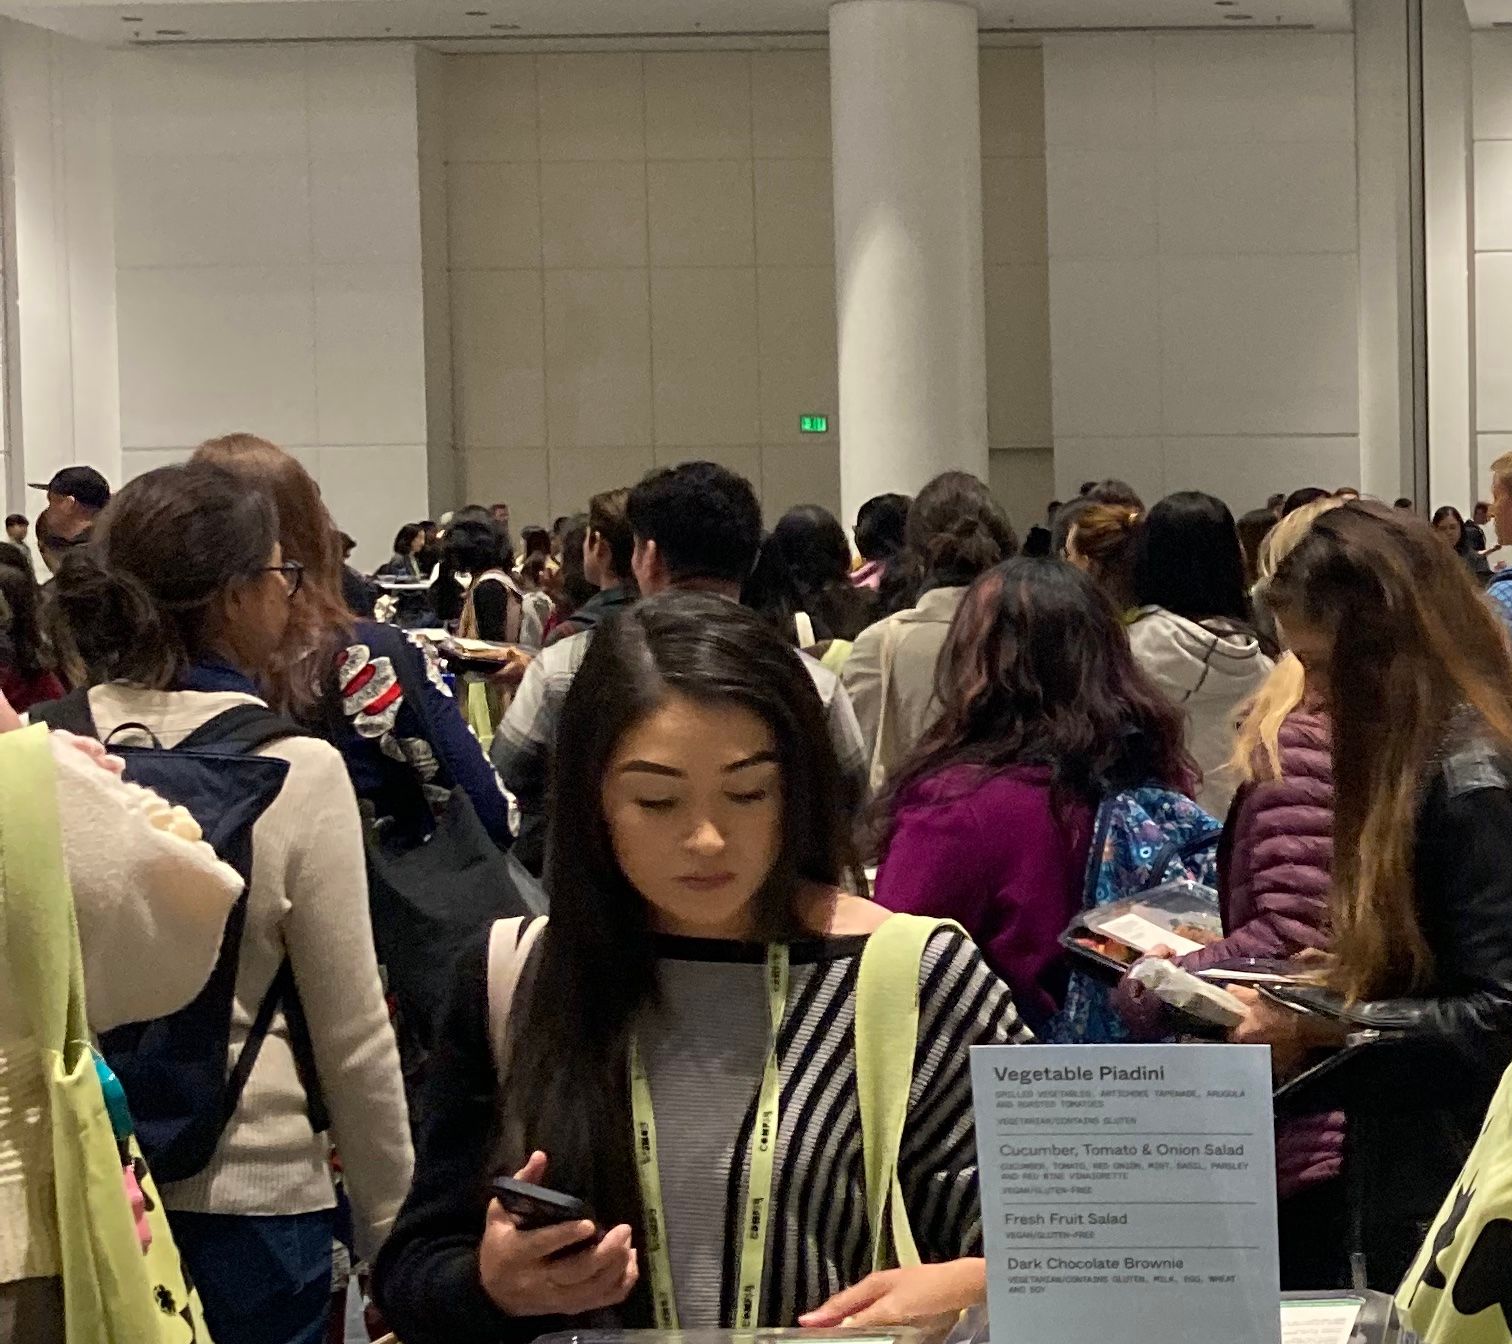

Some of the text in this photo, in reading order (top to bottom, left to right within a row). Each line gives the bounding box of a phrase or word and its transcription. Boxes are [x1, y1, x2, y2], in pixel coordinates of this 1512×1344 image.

[994, 1066, 1165, 1084] Vegetable Piadini
[1000, 1144, 1244, 1157] Cucumber, Tomato & Onion Salad
[1005, 1213, 1128, 1225] Fresh Fruit Salad
[1008, 1257, 1184, 1270] Dark Chocolate Brownie
